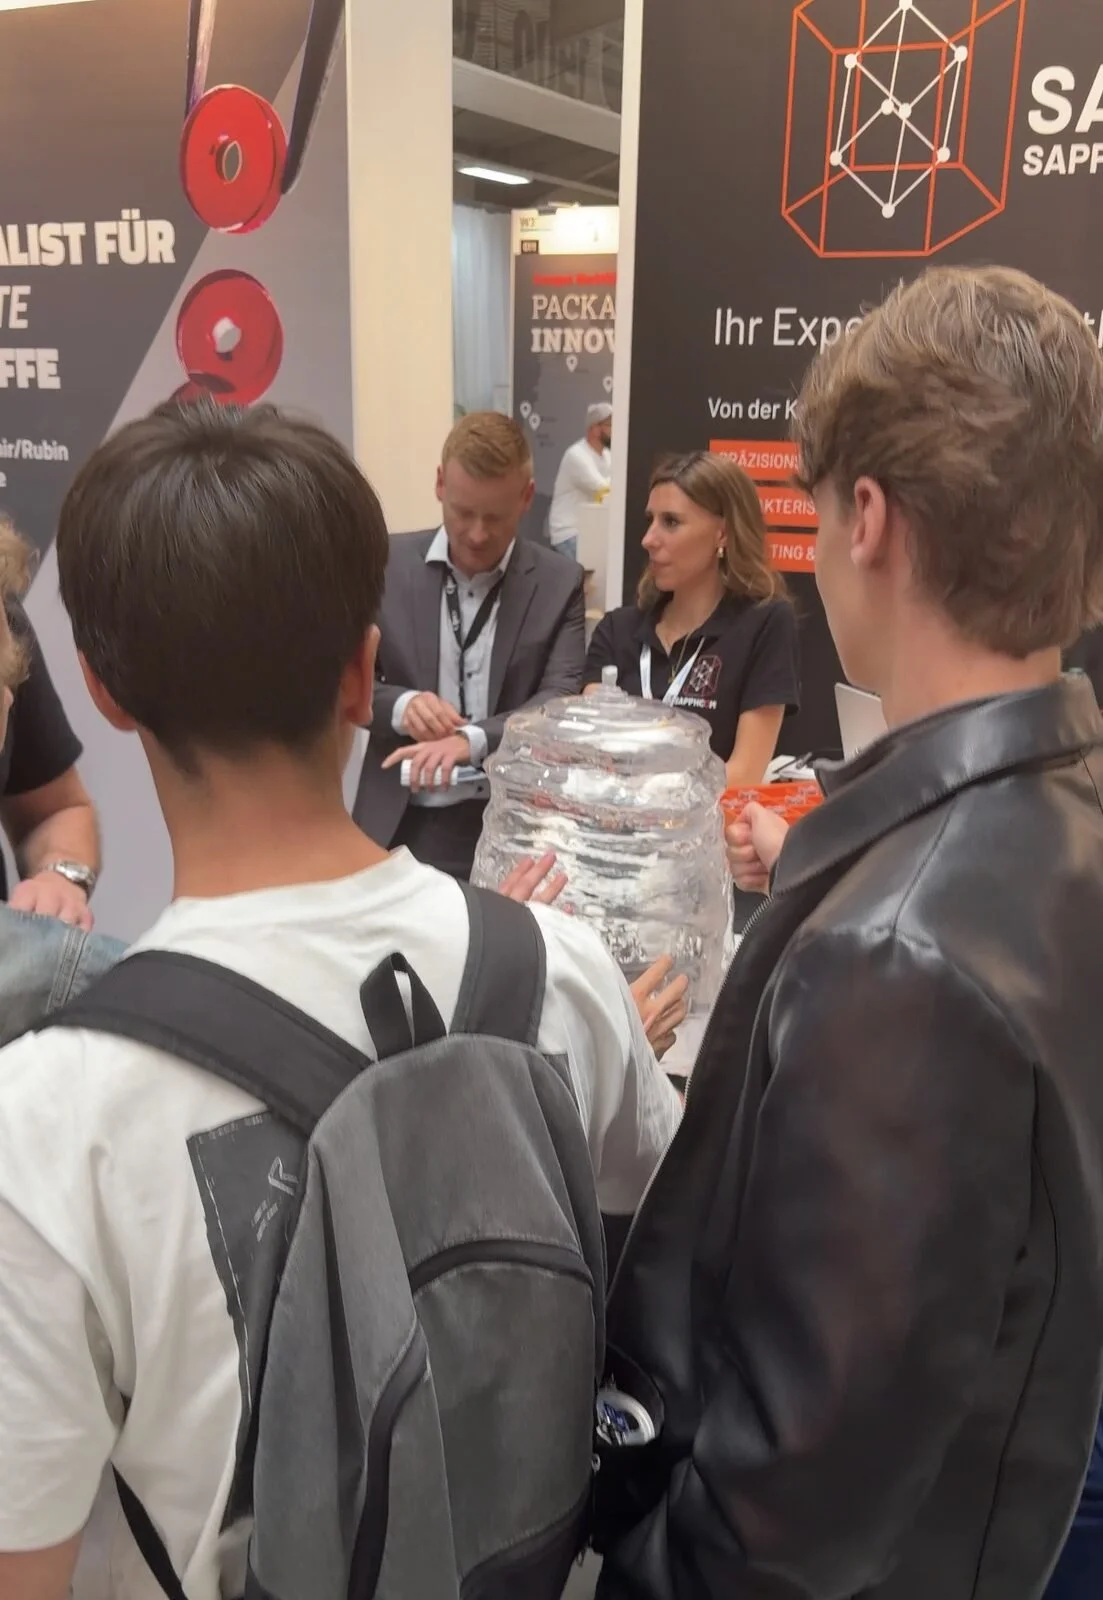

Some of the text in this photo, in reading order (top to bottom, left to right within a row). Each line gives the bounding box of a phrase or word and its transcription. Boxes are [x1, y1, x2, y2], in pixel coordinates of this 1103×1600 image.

[1028, 64, 1103, 135] SA
[1022, 142, 1103, 176] SAPP
[94, 208, 176, 265] FÜR
[531, 293, 616, 320] PACKA
[714, 307, 763, 346] Ihr
[707, 396, 743, 419] Von
[747, 397, 781, 420] der
[0, 437, 69, 461] ir/Rubin
